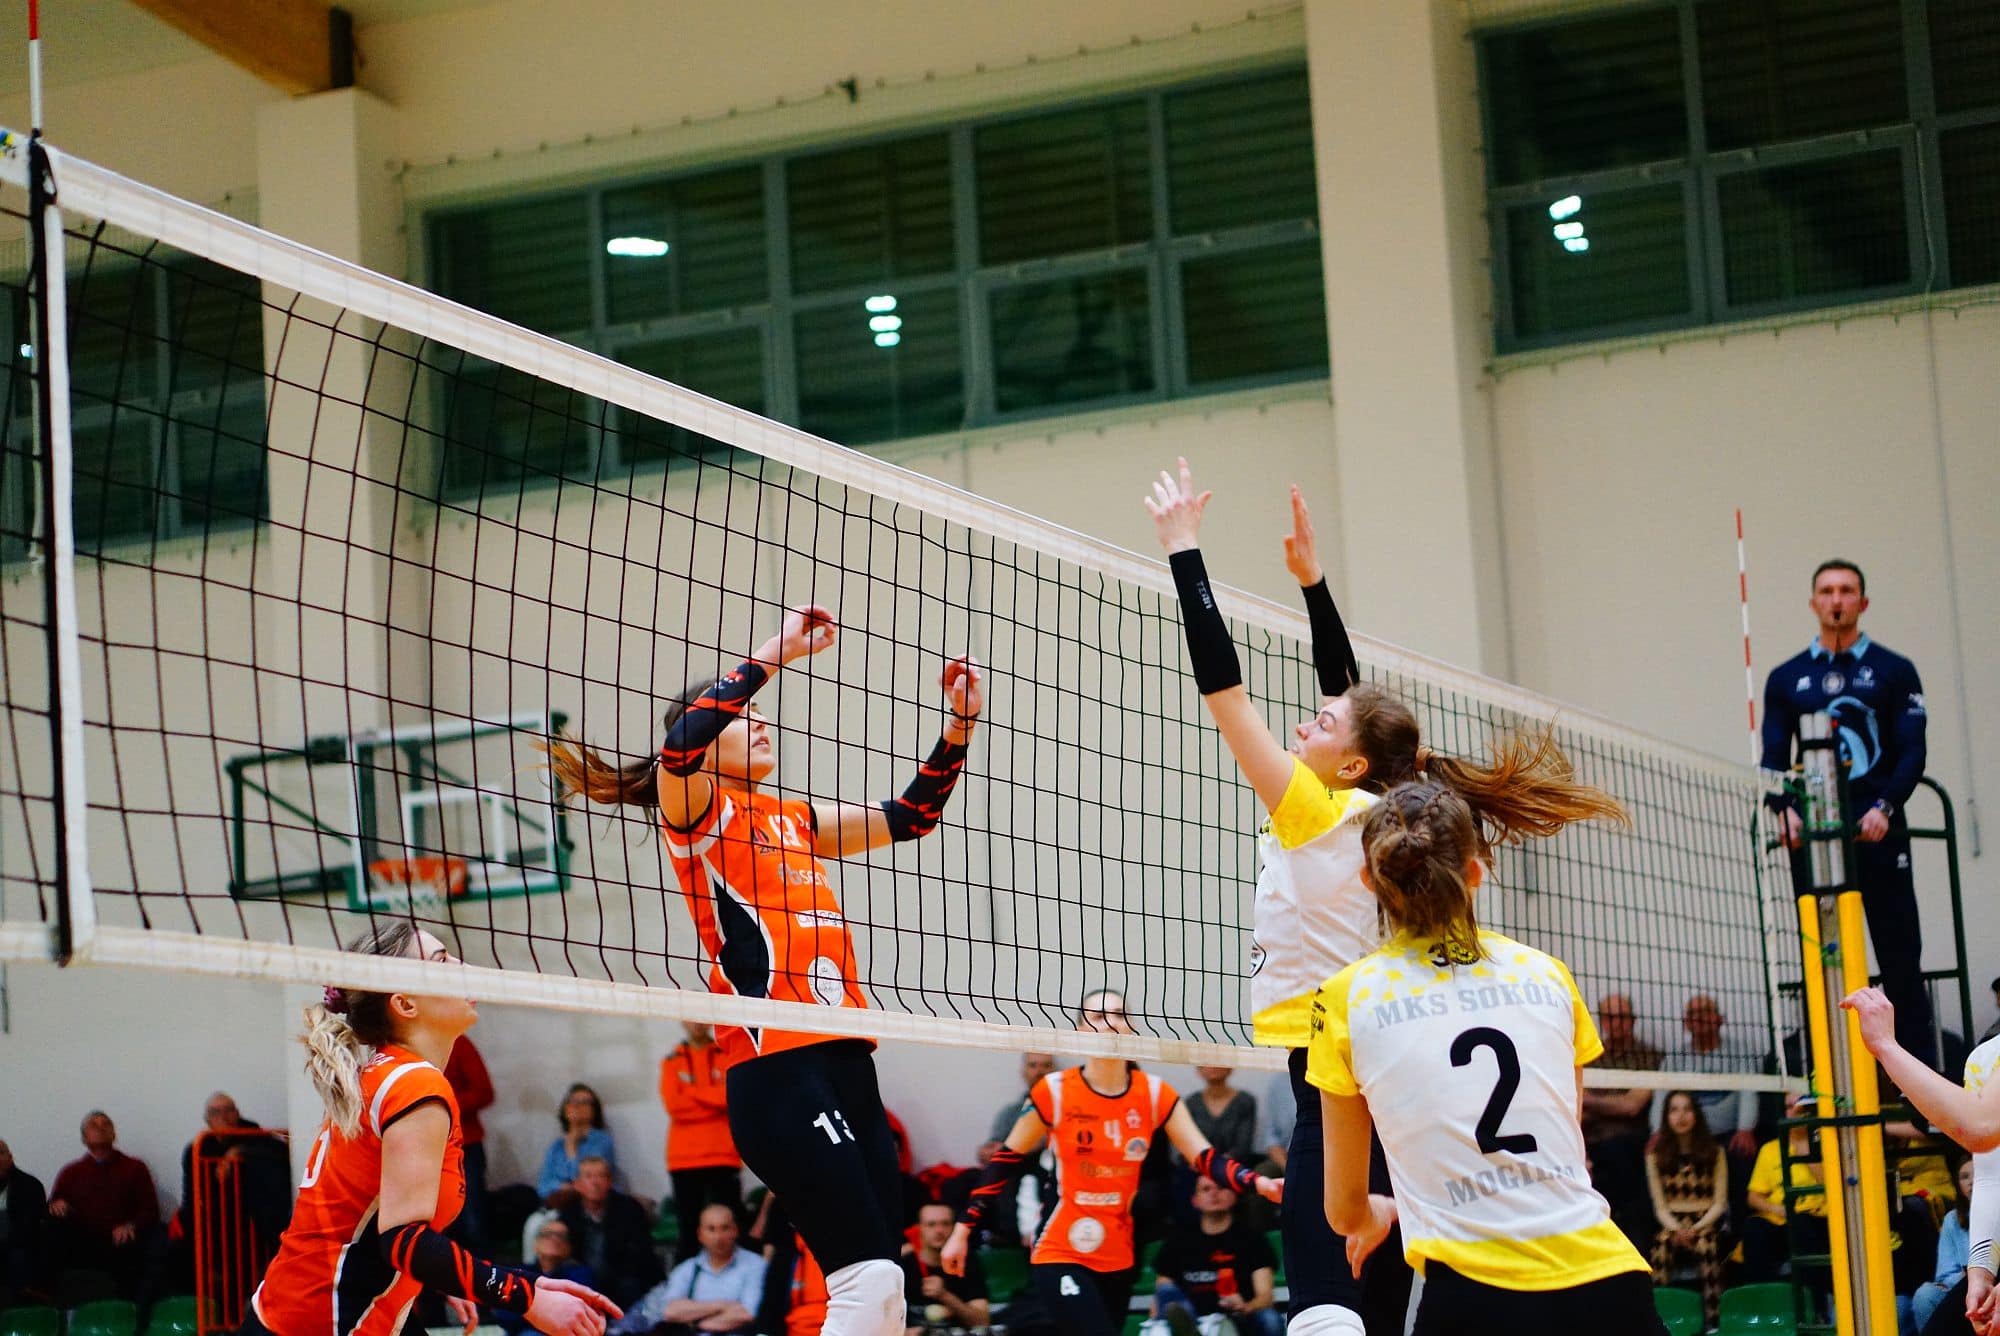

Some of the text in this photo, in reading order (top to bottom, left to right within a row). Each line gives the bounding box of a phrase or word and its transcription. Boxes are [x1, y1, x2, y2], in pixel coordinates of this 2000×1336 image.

[1373, 993, 1449, 1029] MKS
[1450, 1027, 1538, 1154] 2
[813, 1109, 856, 1144] 13
[1103, 1120, 1122, 1148] 4
[1445, 1162, 1576, 1206] MOGIL
[1060, 1275, 1080, 1296] 4
